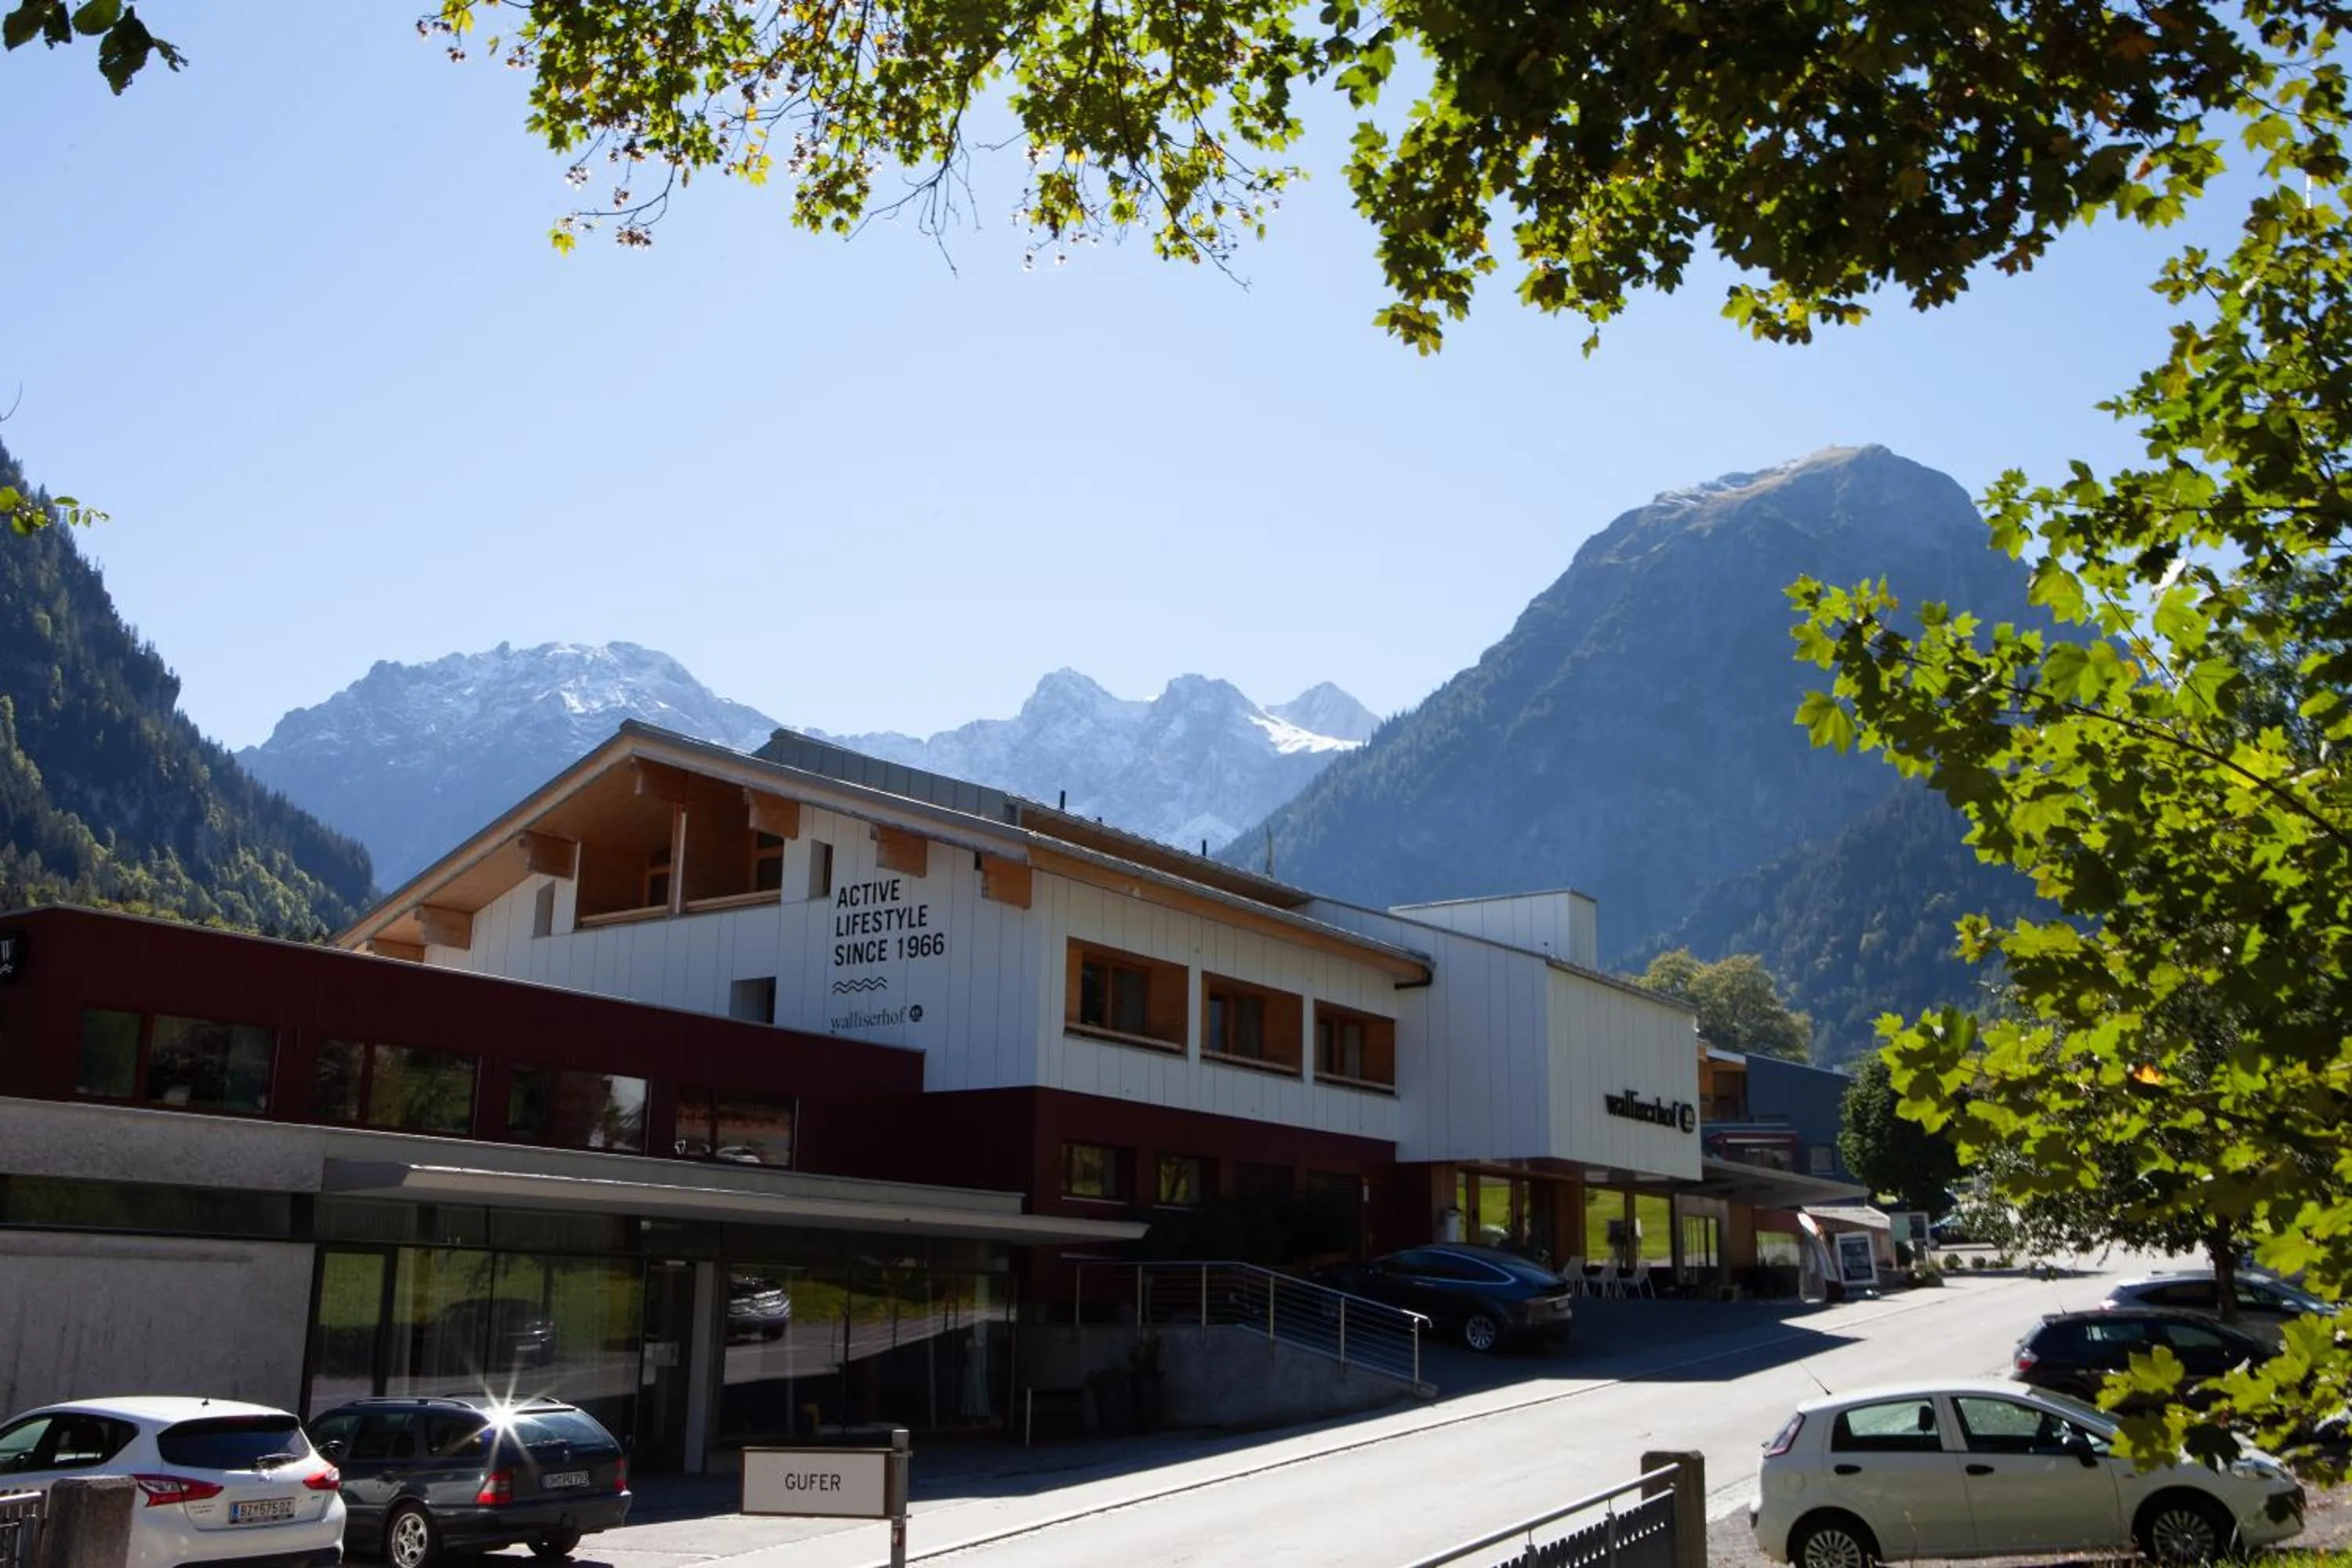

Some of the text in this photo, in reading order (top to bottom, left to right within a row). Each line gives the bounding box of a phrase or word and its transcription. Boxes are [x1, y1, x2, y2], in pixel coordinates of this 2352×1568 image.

[837, 879, 901, 908] ACTIVE
[835, 905, 928, 937] LIFESTYLE
[833, 933, 945, 967] SINCE 1966
[830, 1005, 908, 1029] walliserhof
[1605, 1089, 1679, 1128] walliserhof
[785, 1473, 841, 1491] GUFER
